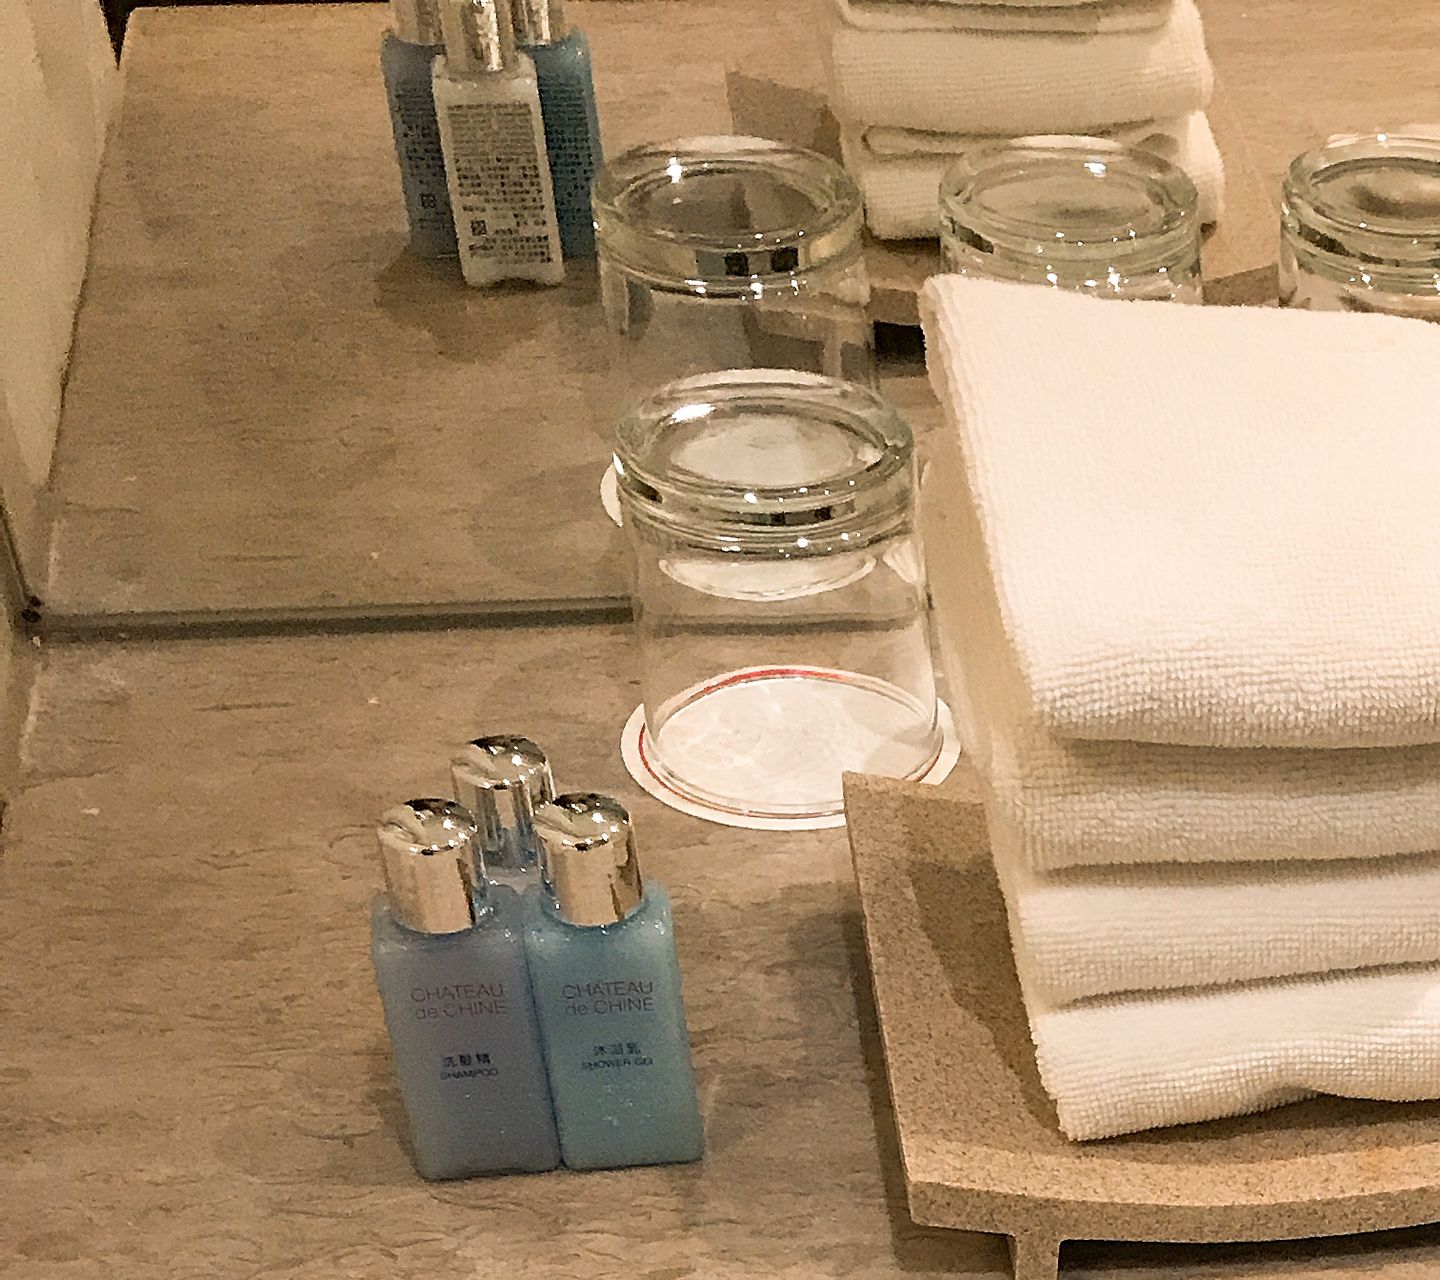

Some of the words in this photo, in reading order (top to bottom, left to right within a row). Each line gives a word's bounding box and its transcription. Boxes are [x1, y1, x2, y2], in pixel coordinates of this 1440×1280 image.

[410, 983, 504, 1002] CHATEAU
[563, 981, 653, 999] CHATEAU
[415, 1004, 440, 1020] de
[443, 1000, 507, 1018] CHINE
[565, 1001, 588, 1016] de
[594, 997, 655, 1015] CHINE
